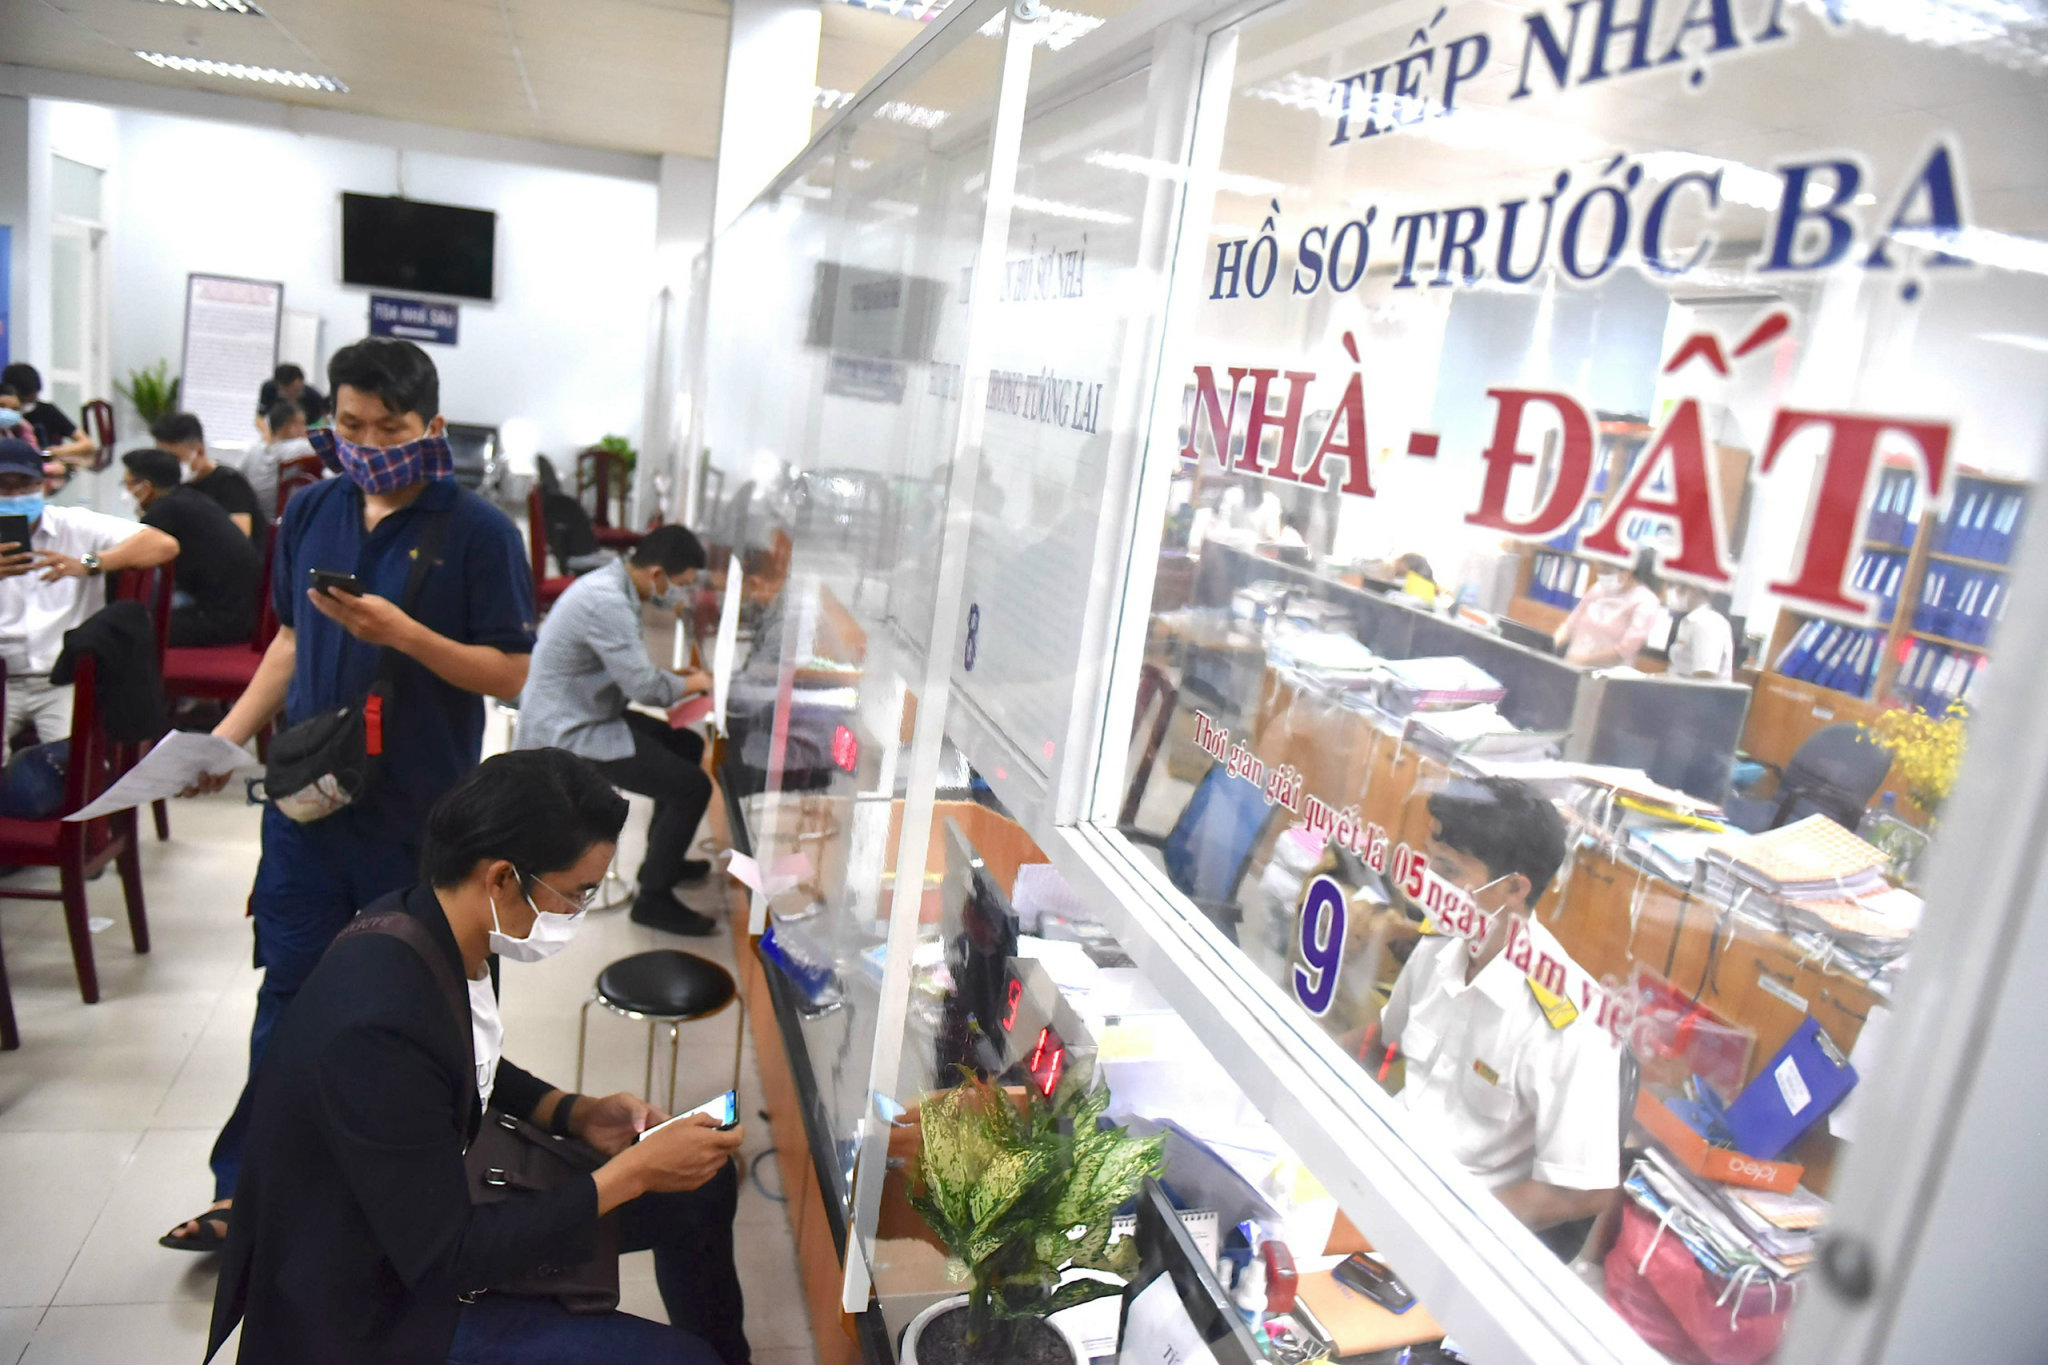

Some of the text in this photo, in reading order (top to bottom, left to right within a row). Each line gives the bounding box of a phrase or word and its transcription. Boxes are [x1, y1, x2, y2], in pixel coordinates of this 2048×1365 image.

[1329, 6, 1491, 147] TIẾP
[1209, 144, 1977, 302] HỒ SƠ TRƯỚC BẠ
[1071, 381, 1103, 434] LAI
[1180, 331, 1377, 498] NHÀ
[1464, 312, 1952, 615] ĐẤT
[964, 602, 980, 672] 8
[1194, 711, 1229, 761] Thời
[1226, 740, 1263, 786] gian
[1265, 764, 1303, 812] giải
[1303, 797, 1362, 852] quyết
[1391, 844, 1426, 898] 05
[1294, 878, 1344, 1014] 9
